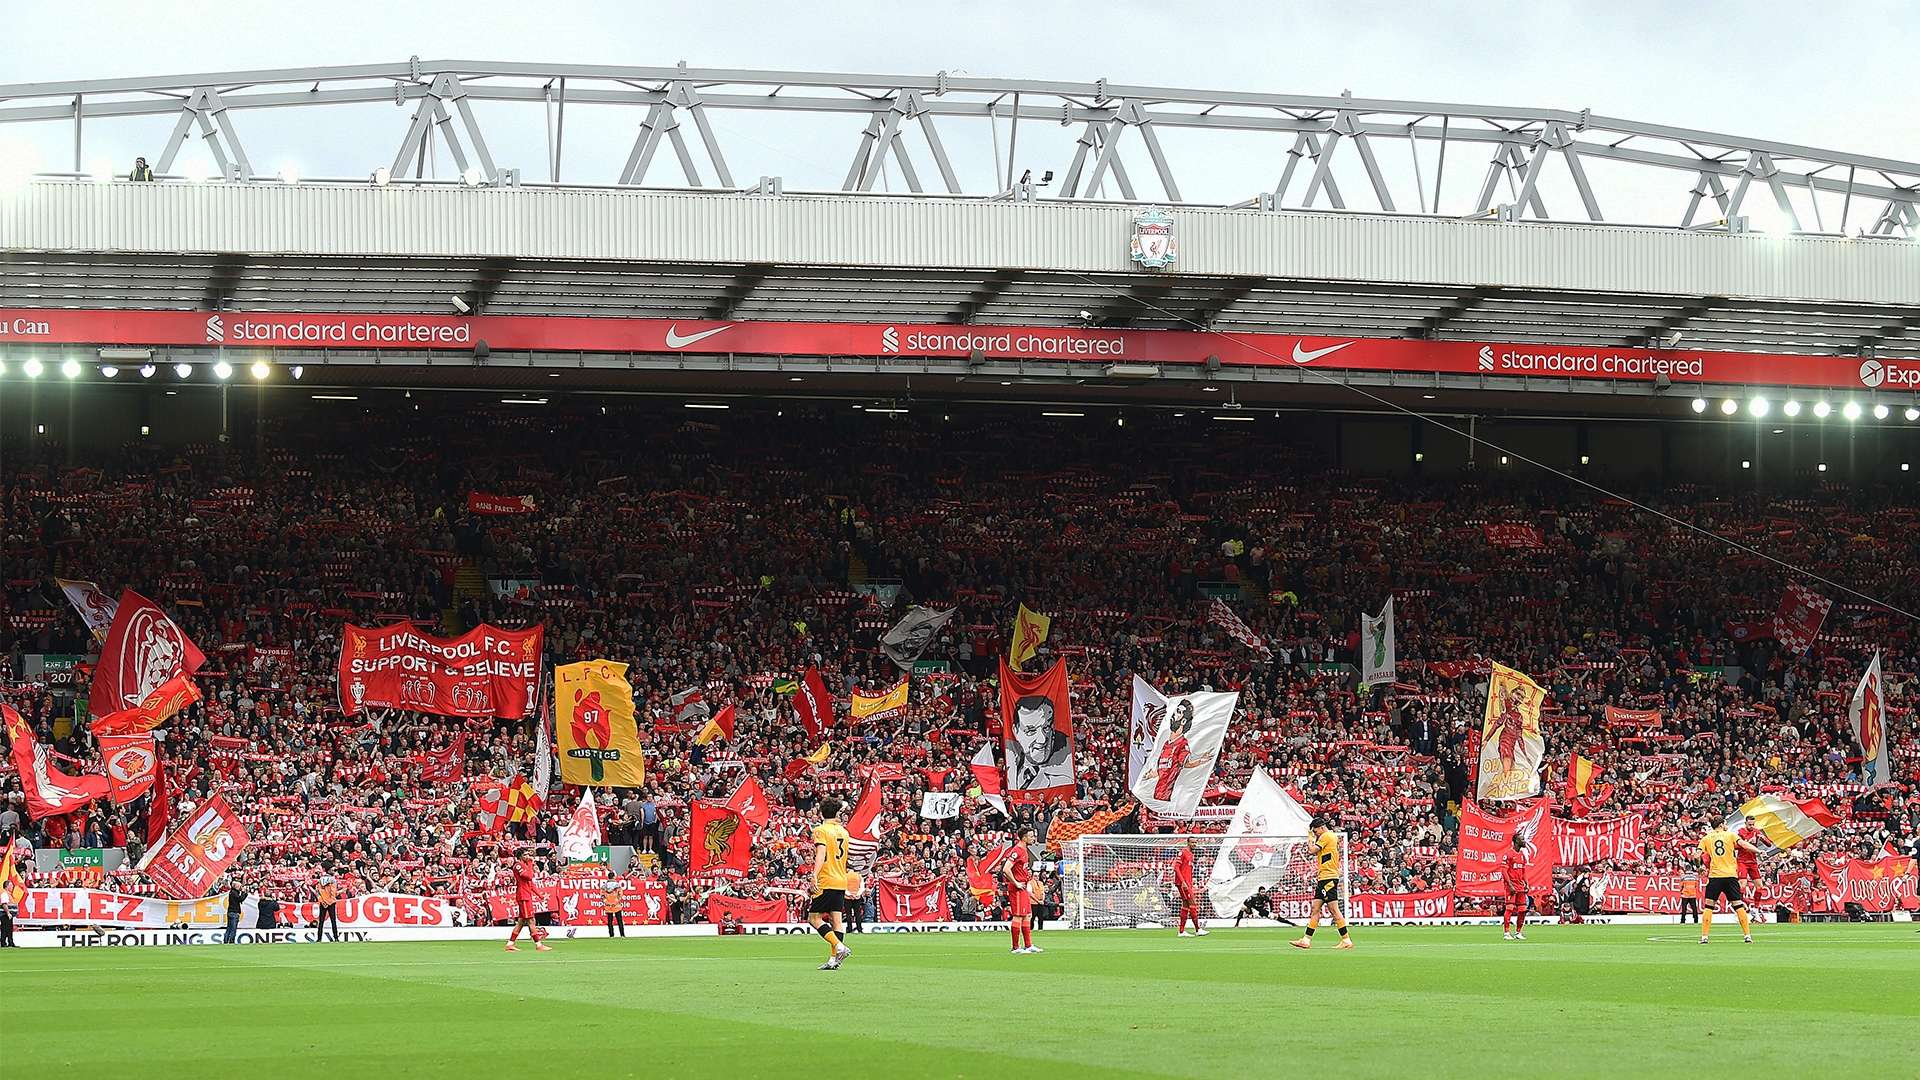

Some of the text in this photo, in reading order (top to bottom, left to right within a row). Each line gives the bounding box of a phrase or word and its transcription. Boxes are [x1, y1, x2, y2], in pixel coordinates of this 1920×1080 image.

[14, 319, 50, 334] Can
[233, 320, 470, 342] standard chartered
[907, 330, 1124, 354] standard chartered
[1501, 350, 1702, 376] standard chartered
[379, 632, 515, 660] LIVERPOOL F.C.
[350, 654, 439, 674] SUPPORT
[463, 659, 536, 678] BELIEVE
[51, 672, 72, 683] 207
[584, 711, 599, 723] 97
[1482, 829, 1504, 841] EARTH
[835, 838, 844, 860] 3
[1558, 836, 1593, 866] WIN
[1715, 840, 1725, 856] 8
[64, 856, 83, 864] EXIT
[1609, 876, 1635, 891] WE
[1645, 877, 1681, 892] ARE
[273, 896, 443, 926] ROUGES
[896, 894, 913, 917] H
[1371, 902, 1405, 919] LAW
[1415, 896, 1449, 917] NOW
[1610, 896, 1645, 911] THE
[57, 934, 97, 947] THE
